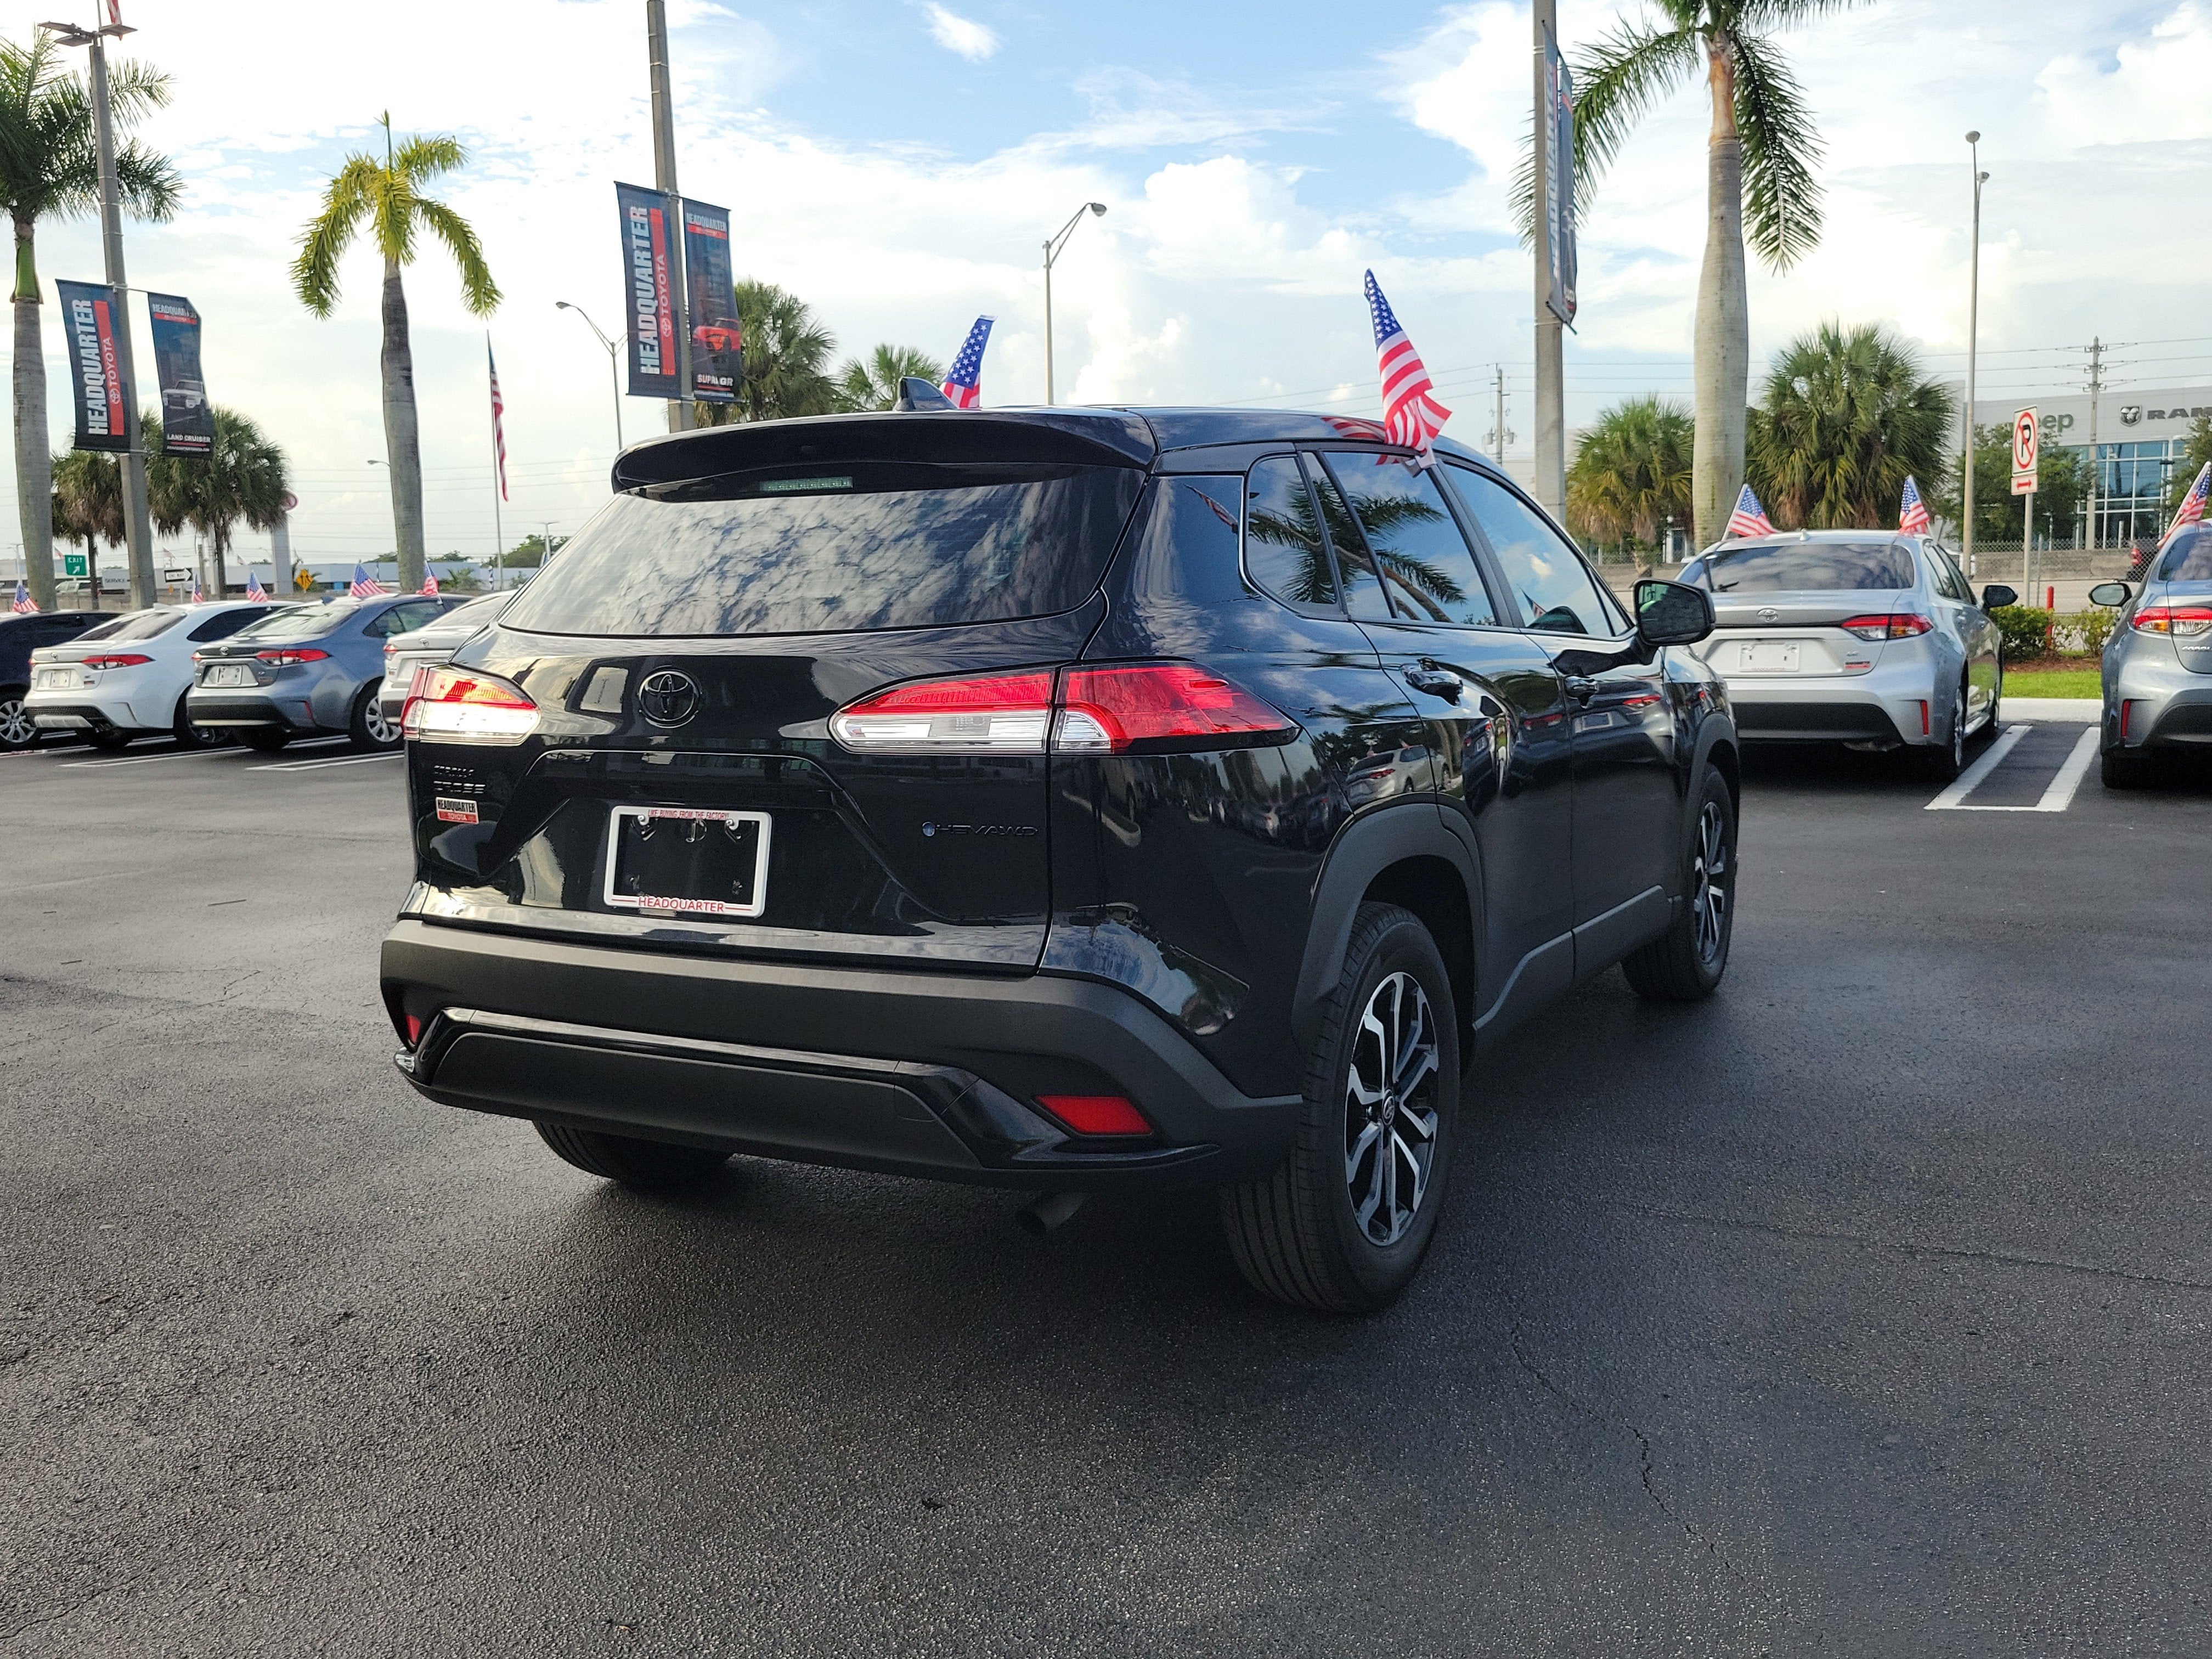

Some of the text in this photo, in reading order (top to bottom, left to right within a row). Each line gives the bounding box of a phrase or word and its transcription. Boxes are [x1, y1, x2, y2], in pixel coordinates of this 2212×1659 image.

[629, 206, 660, 375] HEADQUARTER
[657, 254, 669, 315] TOYOTA
[72, 300, 109, 435] HEADQUARTER
[103, 337, 117, 387] TOYOTA
[719, 376, 733, 386] GR
[184, 435, 211, 443] CRUISER
[438, 799, 477, 813] HEADQUARTER
[448, 812, 467, 821] TOYOTA
[659, 810, 677, 819] BUYING
[679, 810, 693, 819] FROM
[639, 897, 724, 912] HEADQUARTER
